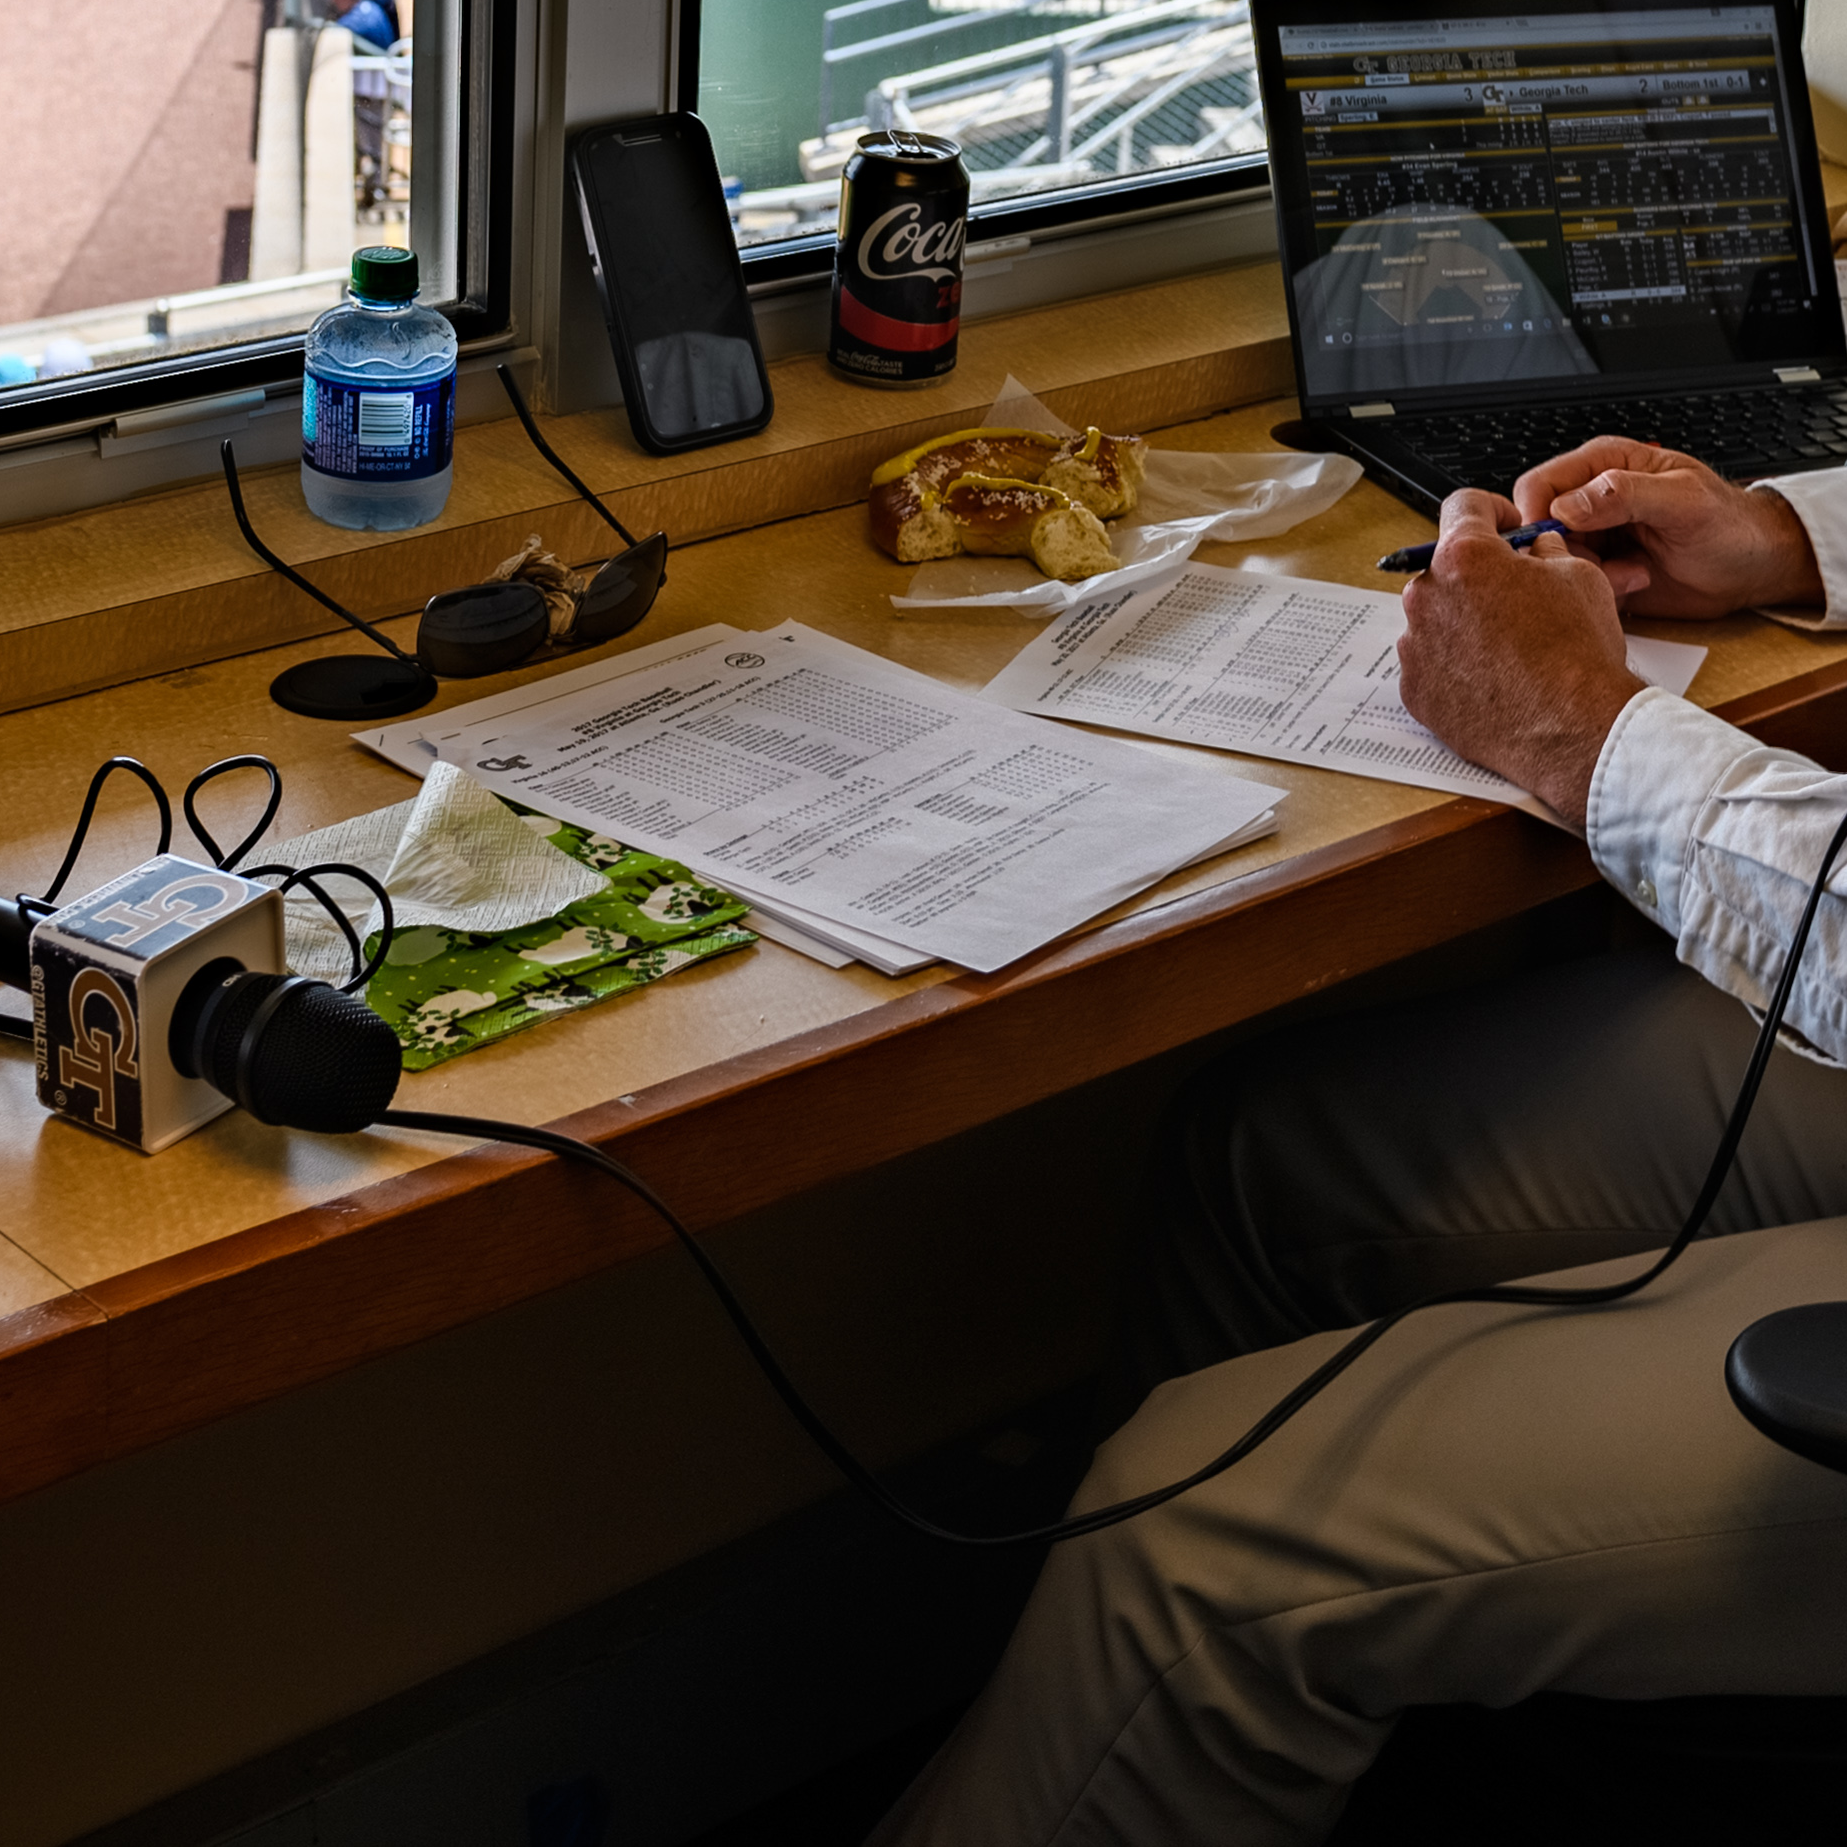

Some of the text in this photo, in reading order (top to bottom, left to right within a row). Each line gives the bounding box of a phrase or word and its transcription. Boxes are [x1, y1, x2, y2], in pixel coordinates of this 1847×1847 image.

[1386, 53, 1464, 74] GEORGIA
[1468, 50, 1518, 70] TECH
[1638, 79, 1649, 94] 2
[1662, 74, 1719, 91] Bottom 1st
[1725, 72, 1745, 89] 0-1
[1463, 87, 1474, 103] 3
[1519, 84, 1589, 100] Georgia Tech
[1330, 93, 1388, 108] #8 Virginia
[556, 742, 577, 753] May
[30, 963, 50, 1083] @GTATHLETICS
